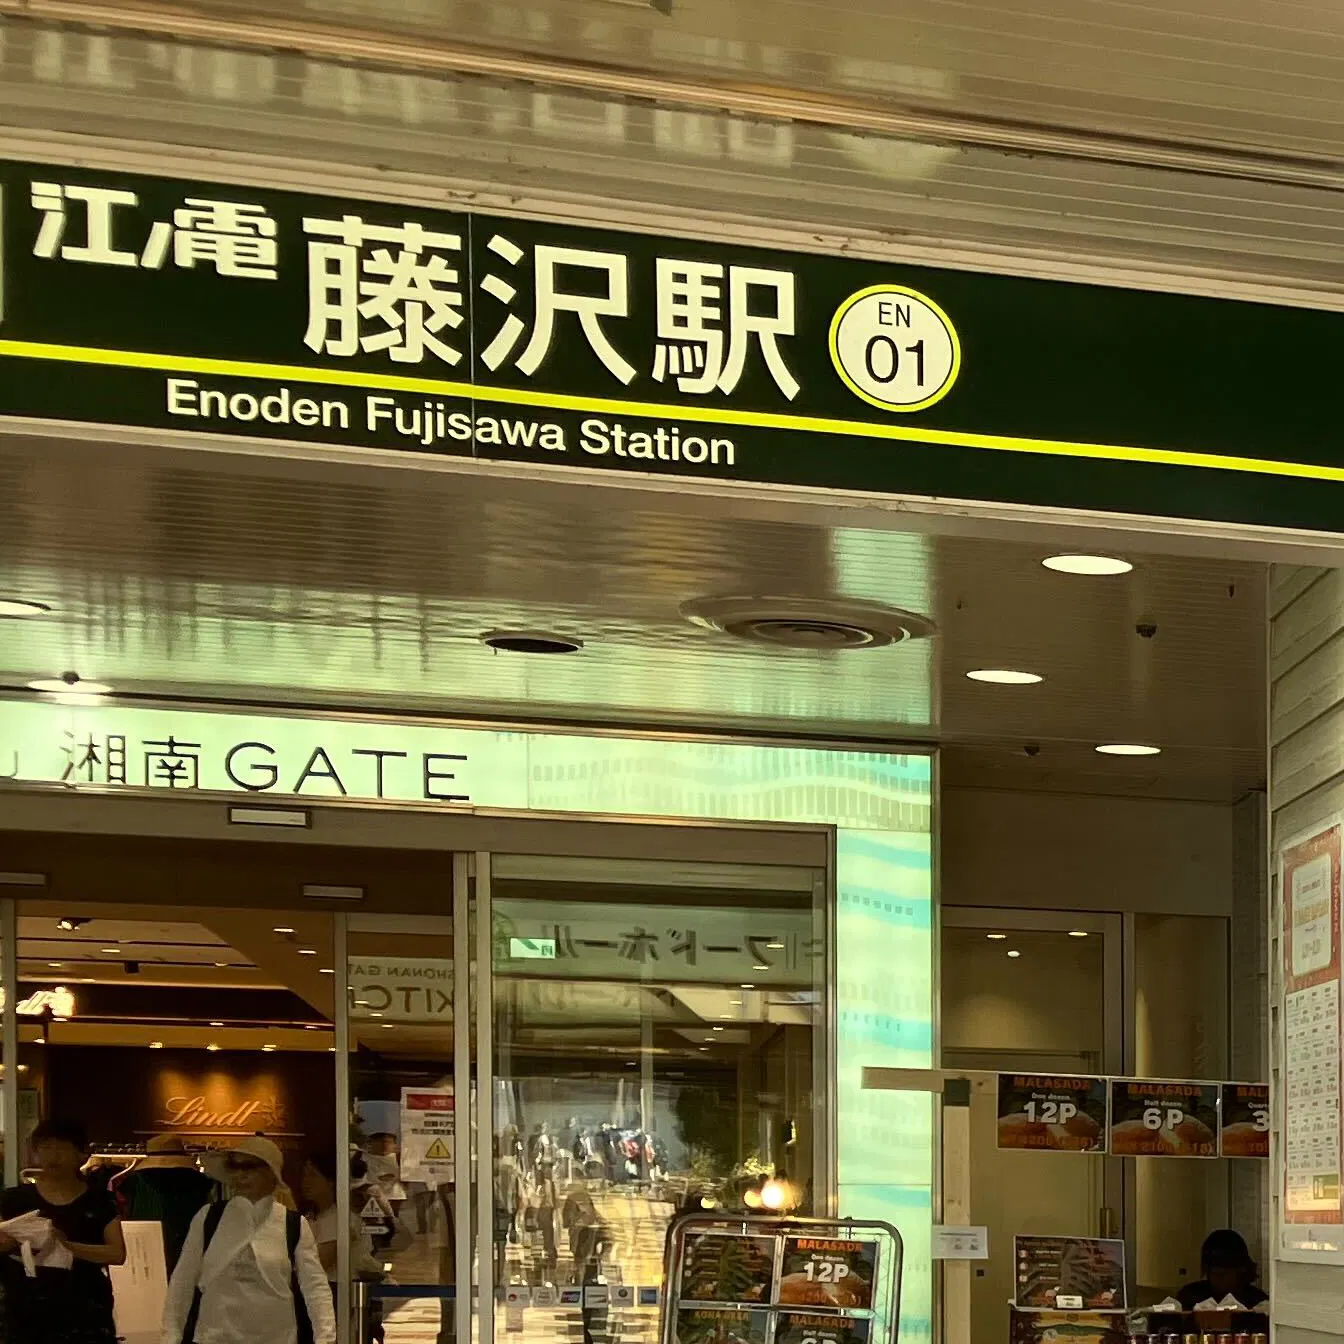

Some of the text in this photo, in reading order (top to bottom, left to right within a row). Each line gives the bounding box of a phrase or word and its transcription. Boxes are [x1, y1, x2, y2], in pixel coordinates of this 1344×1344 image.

[302, 214, 803, 402] 藤沢駅
[878, 300, 911, 327] EN
[864, 334, 930, 389] 01
[167, 378, 736, 467] Enoden Fujisawa Station
[154, 1096, 261, 1128] Lindt
[1023, 1101, 1078, 1125] 12P
[1143, 1107, 1184, 1131] 6P
[803, 1261, 849, 1283] 12P
